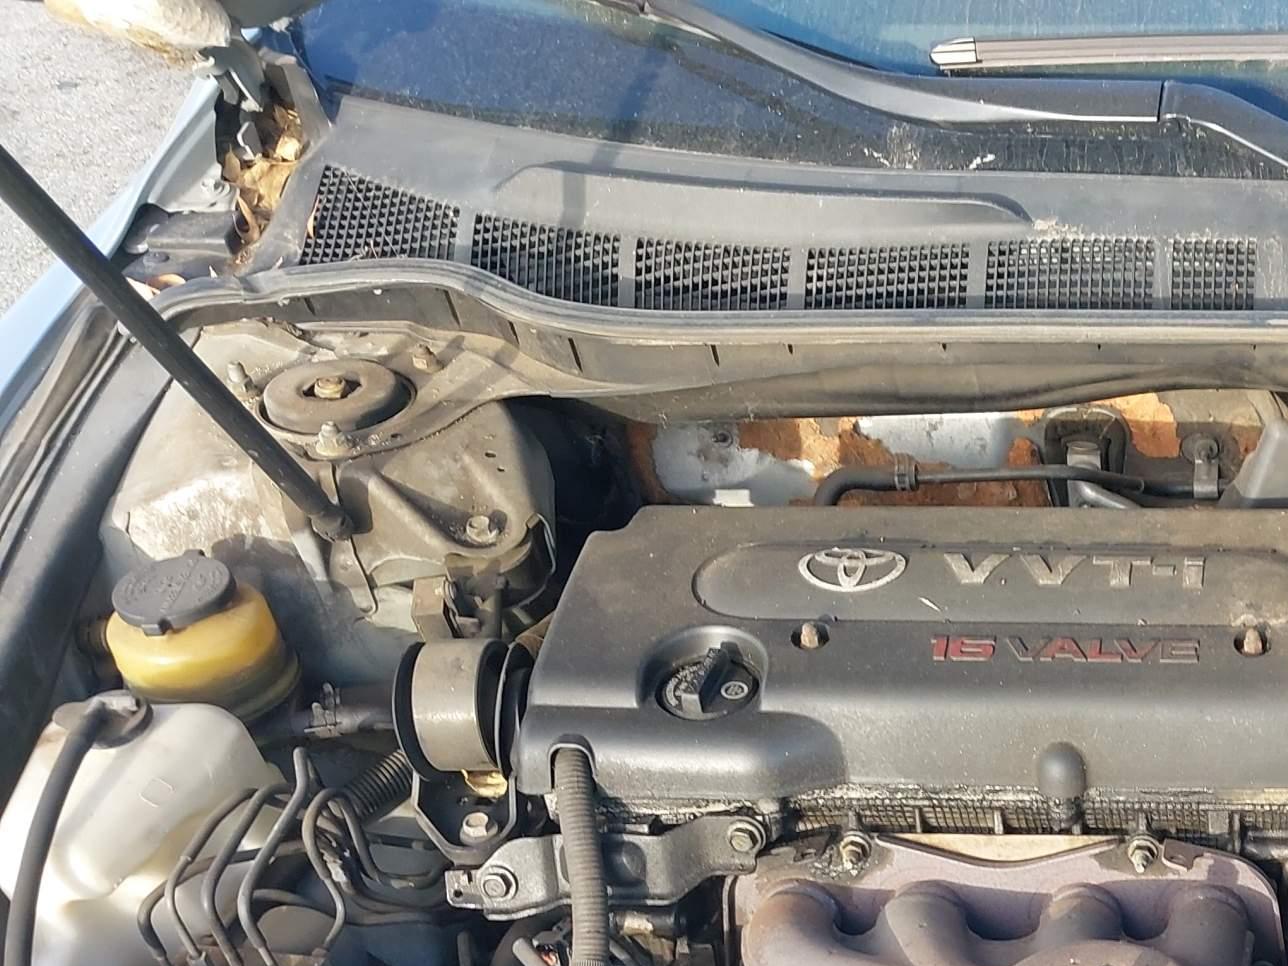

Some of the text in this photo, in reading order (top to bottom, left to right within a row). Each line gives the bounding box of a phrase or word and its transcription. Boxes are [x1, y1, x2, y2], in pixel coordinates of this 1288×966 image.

[944, 553, 1205, 588] VVT-i
[931, 636, 1200, 663] 16 VALVE
